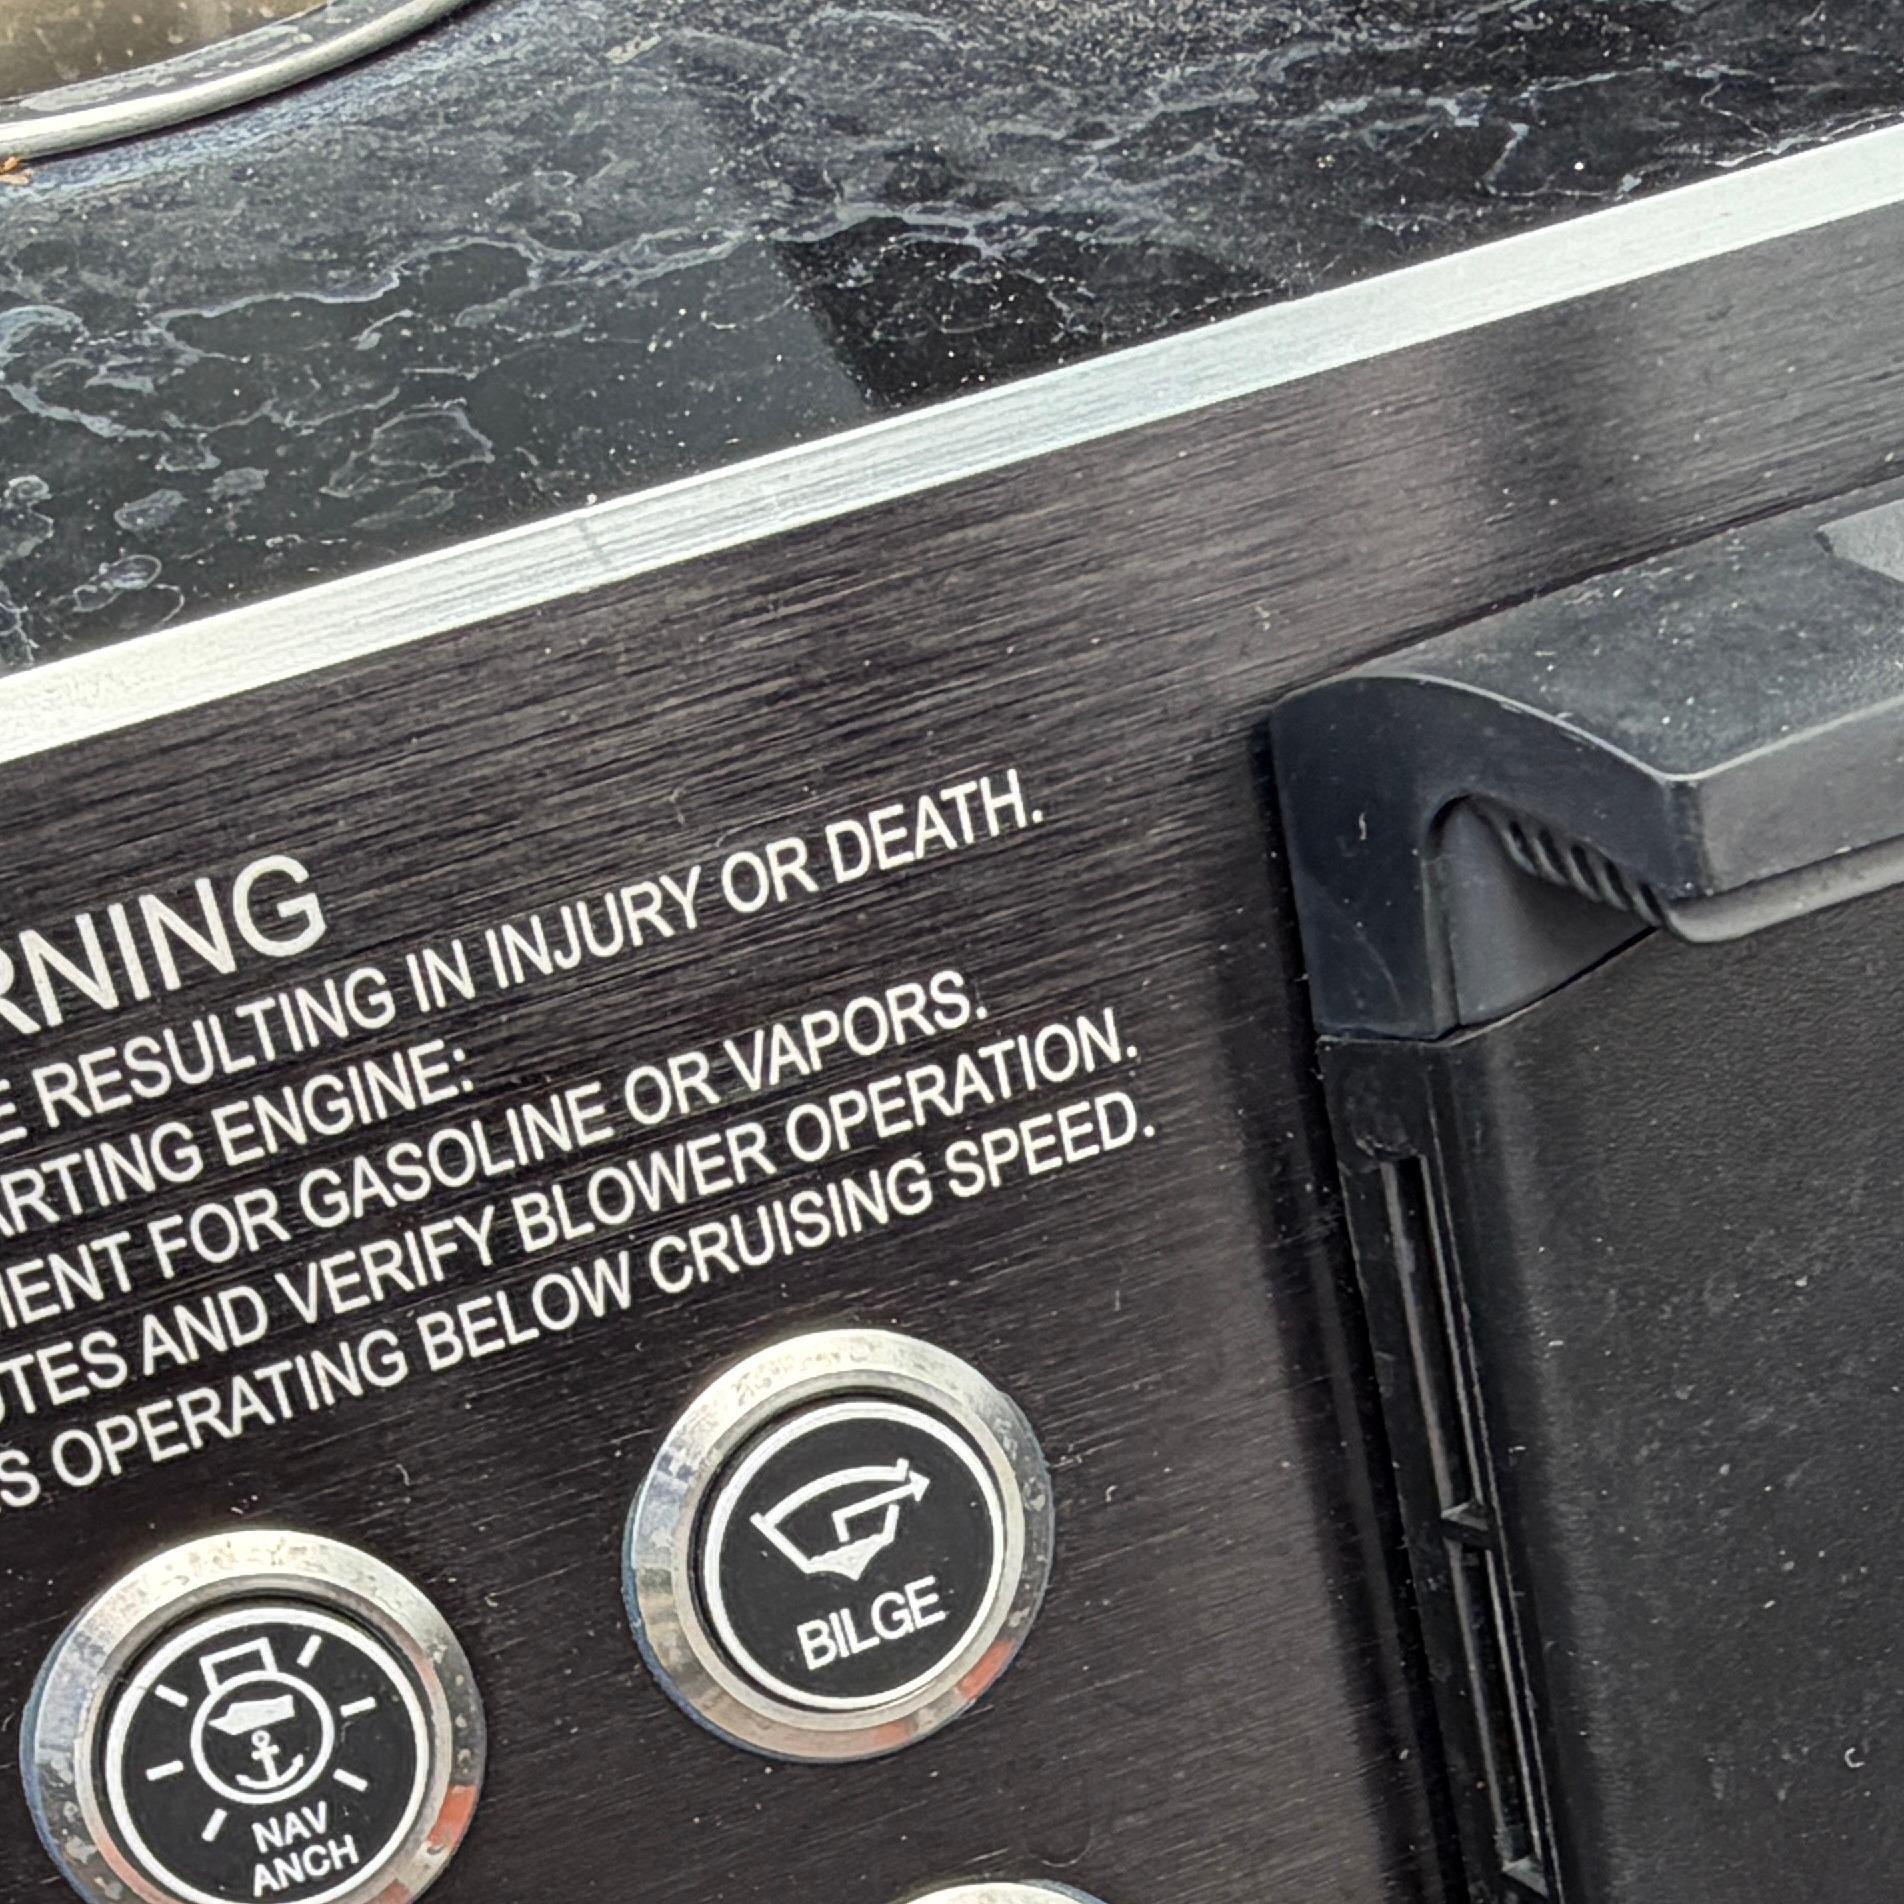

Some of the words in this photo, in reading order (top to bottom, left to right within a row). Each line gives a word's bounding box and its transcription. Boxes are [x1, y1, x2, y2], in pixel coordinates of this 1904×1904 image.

[32, 967, 395, 1127] RESULTING
[406, 939, 475, 1012] IN
[485, 865, 701, 988] INJURY
[721, 837, 819, 913] OR
[825, 769, 1043, 883] DEATH.
[143, 1285, 268, 1375] AND
[275, 1205, 494, 1323] VERIFY
[511, 1123, 777, 1252] BLOWER
[786, 1007, 1137, 1161] OPERATION.
[147, 1188, 291, 1279] FOR
[299, 1081, 614, 1227] GASOLINE
[625, 1051, 721, 1125] OR
[723, 969, 988, 1091] VAPORS.
[211, 1039, 473, 1166] ENGINE:
[51, 1329, 408, 1487] OPERATING
[417, 1251, 631, 1371] BELOW
[649, 1155, 933, 1293] CRUISING
[945, 1091, 1155, 1197] SPEED.
[797, 1576, 946, 1670] BILGE
[252, 1801, 326, 1850] NAV
[254, 1835, 359, 1897] ANCH
